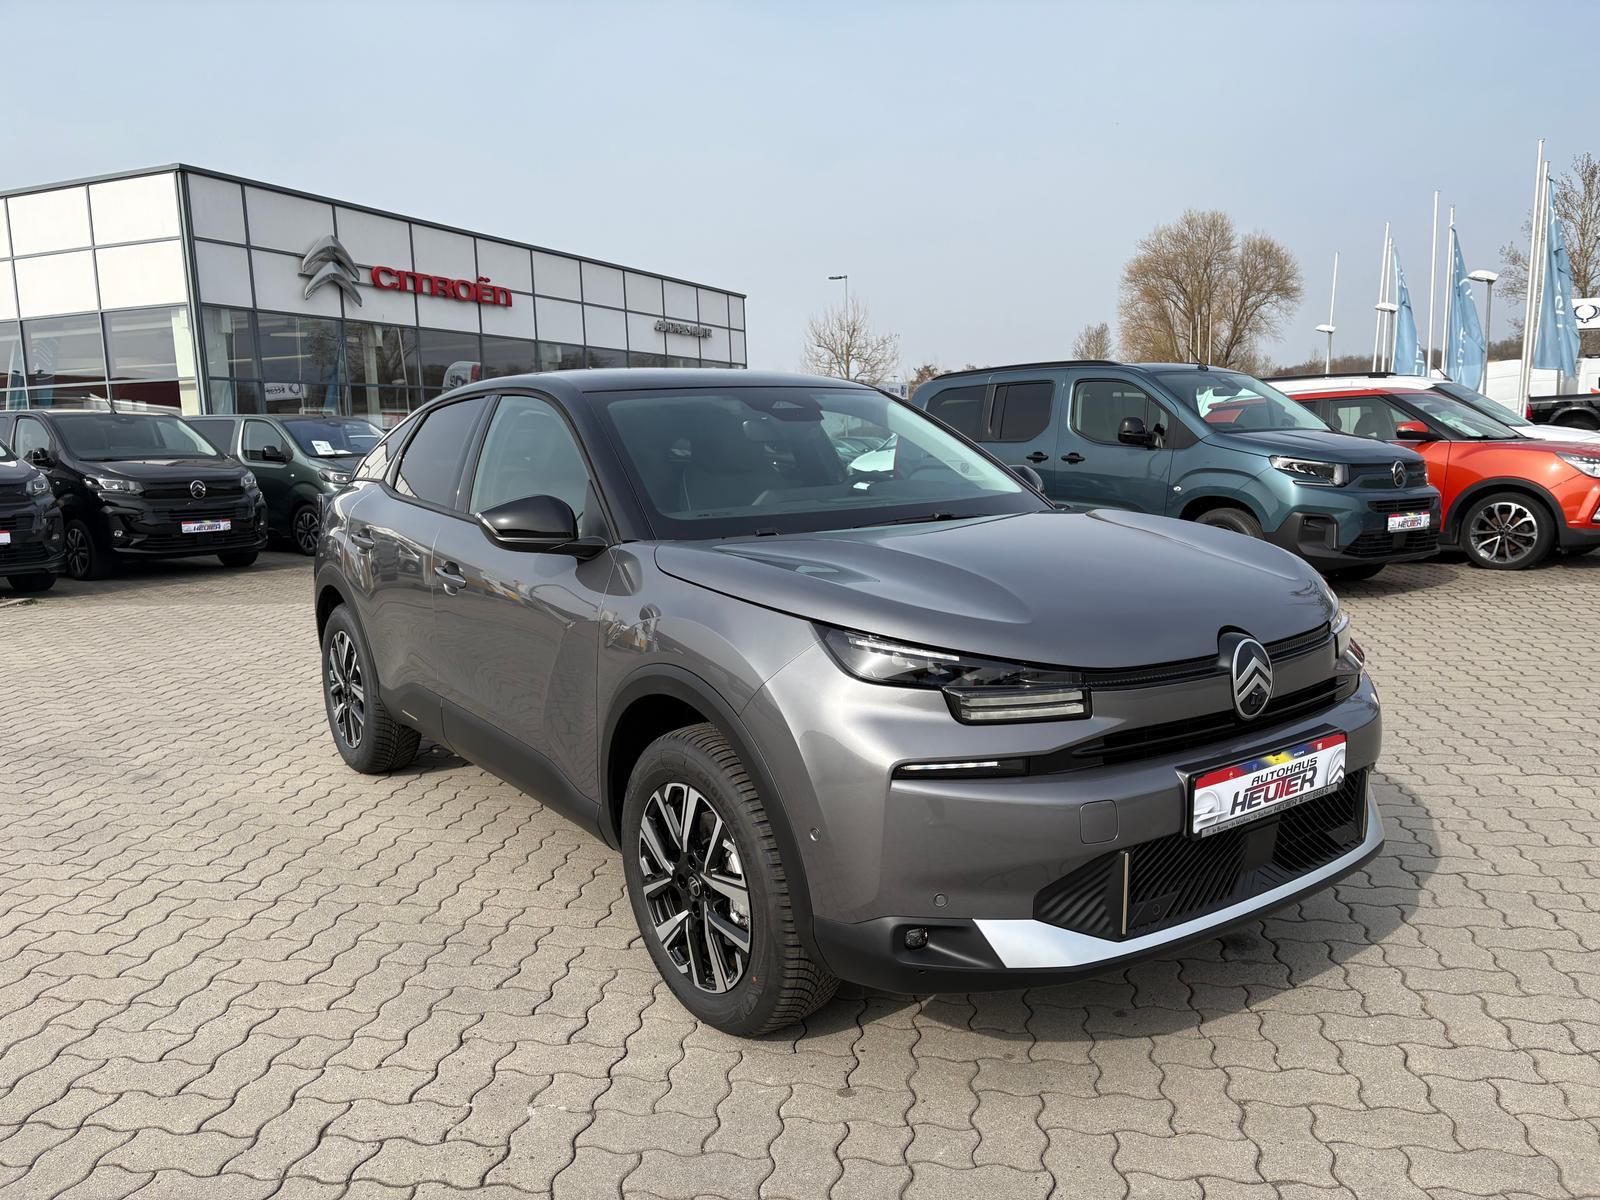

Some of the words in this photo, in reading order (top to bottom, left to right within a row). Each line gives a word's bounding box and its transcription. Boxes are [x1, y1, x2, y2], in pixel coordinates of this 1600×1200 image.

[371, 266, 512, 307] CITROËN
[1230, 766, 1318, 816] HEUTER
[1251, 757, 1318, 786] AUTOHAUS
